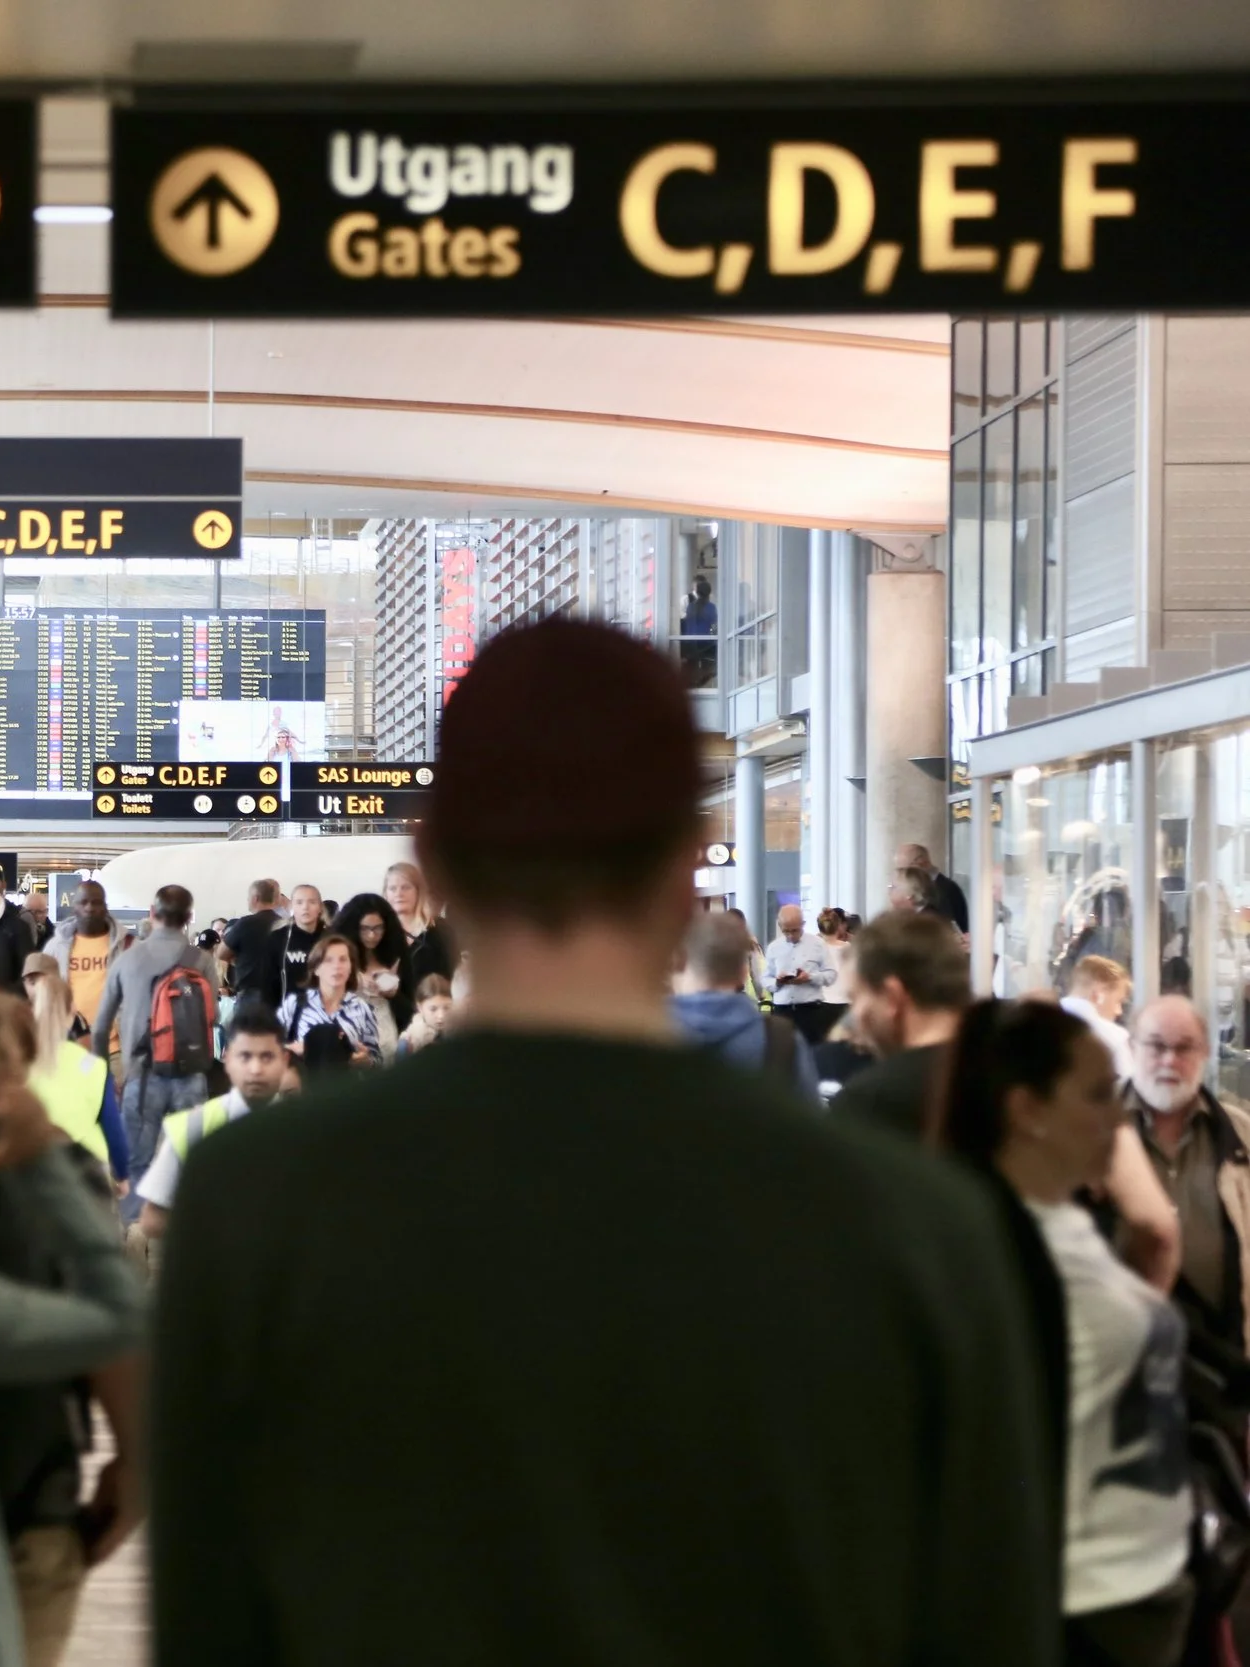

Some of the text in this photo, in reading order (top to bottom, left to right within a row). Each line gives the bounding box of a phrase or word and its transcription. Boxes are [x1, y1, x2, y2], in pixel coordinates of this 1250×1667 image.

[329, 131, 574, 213] Utgang
[620, 139, 1137, 294] C,D,E,F
[329, 212, 521, 279] Gates
[4, 607, 36, 619] 15:57
[120, 764, 154, 777] Utgang
[121, 774, 148, 785] Gates
[158, 766, 227, 787] C,D,E,F
[318, 767, 411, 787] SAS Lounge
[121, 793, 153, 803] Toalett
[318, 796, 384, 814] Ut Exit
[121, 803, 151, 814] Toilets
